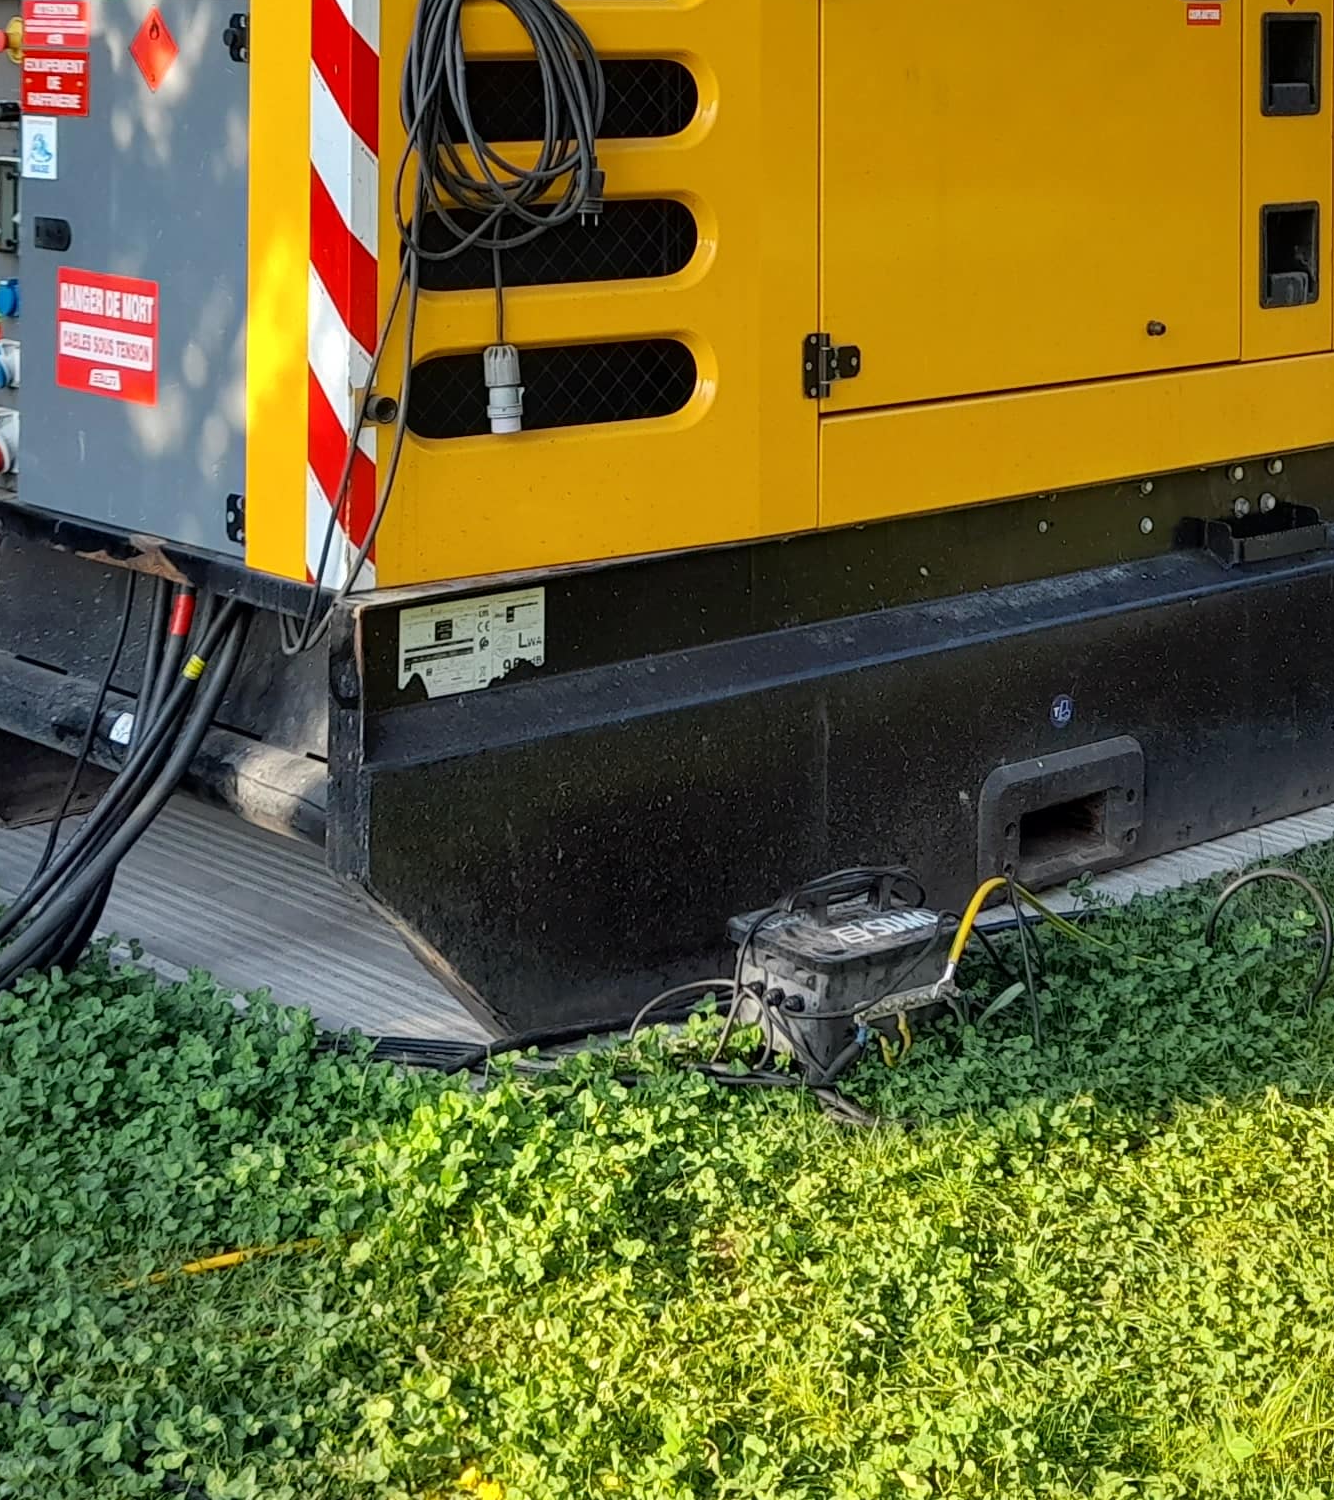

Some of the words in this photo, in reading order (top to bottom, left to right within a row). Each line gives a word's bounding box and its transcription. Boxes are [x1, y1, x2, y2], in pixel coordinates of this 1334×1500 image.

[60, 282, 104, 316] DANGER
[105, 289, 121, 318] DE
[122, 293, 155, 324] MORT
